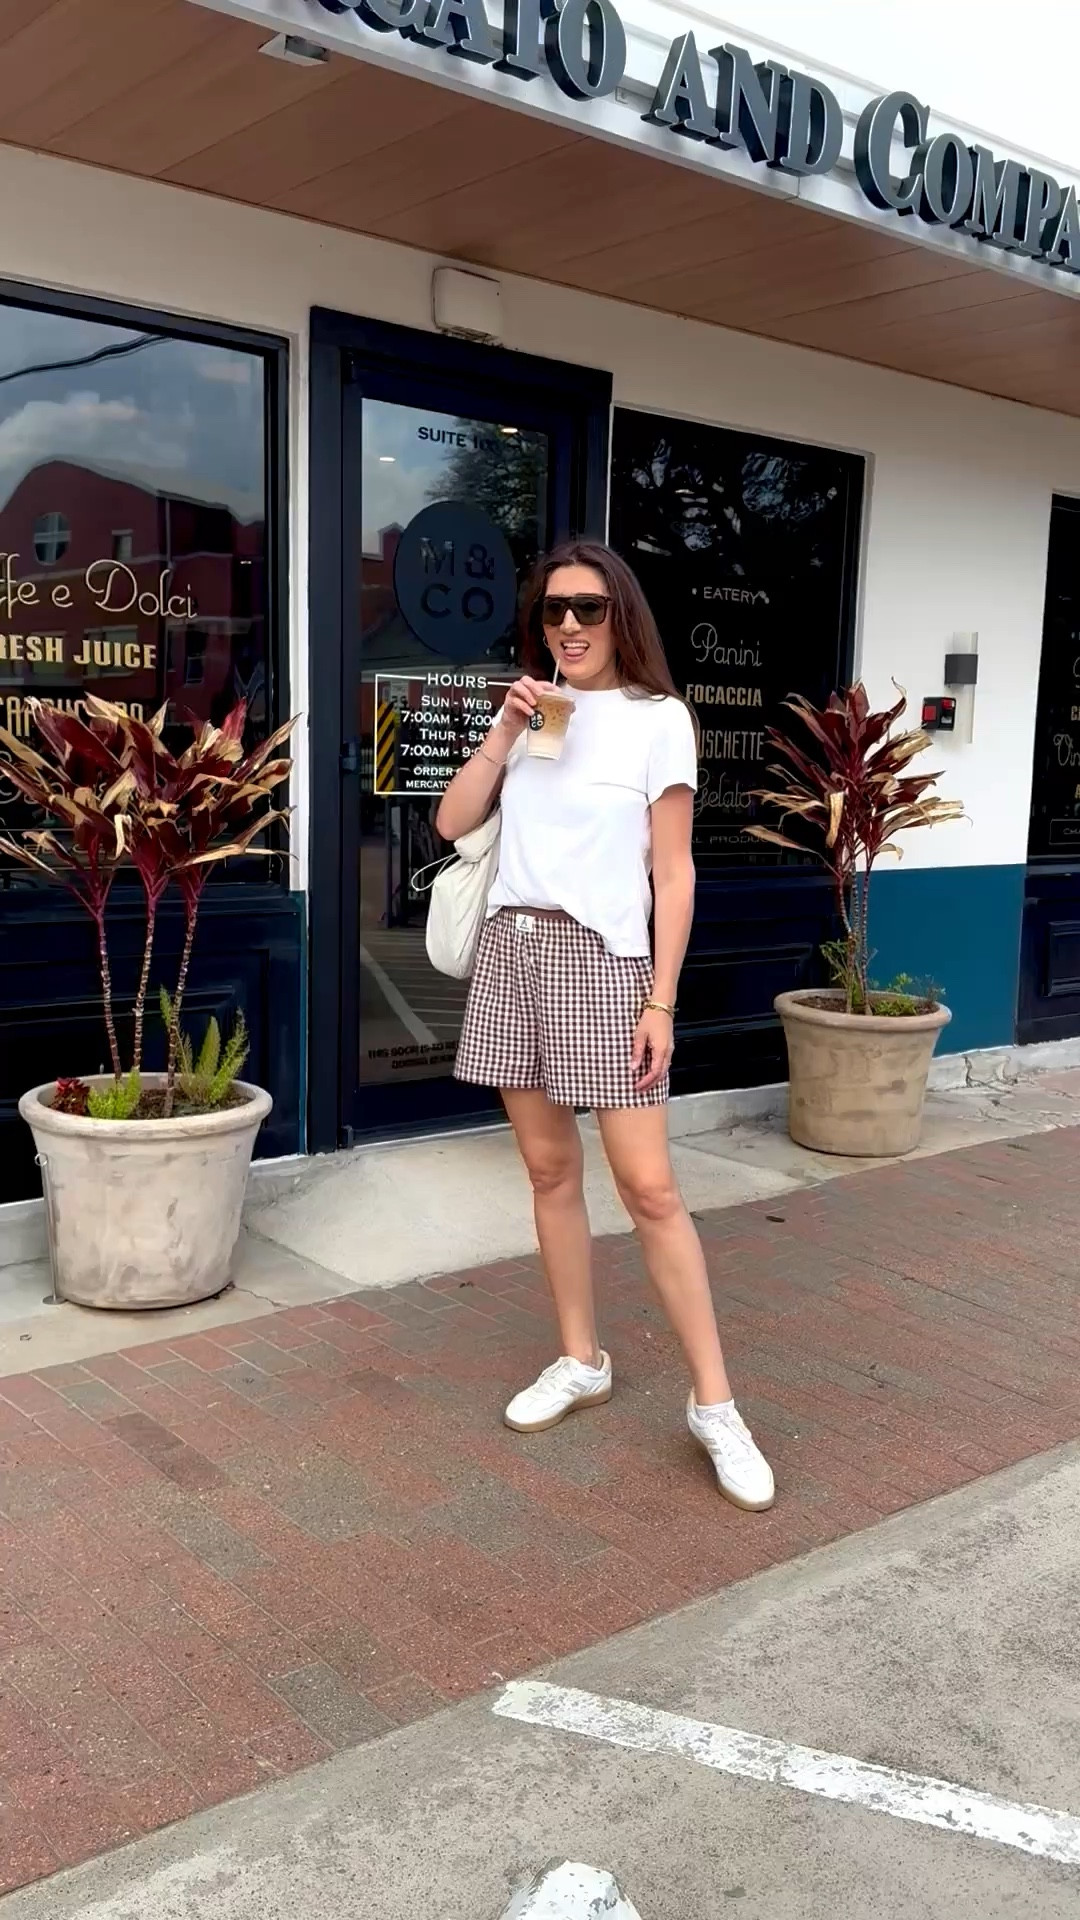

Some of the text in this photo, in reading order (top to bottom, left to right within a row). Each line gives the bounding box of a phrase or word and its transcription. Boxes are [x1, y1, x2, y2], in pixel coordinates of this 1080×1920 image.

[641, 30, 843, 176] AND
[418, 426, 466, 448] SUITE
[51, 584, 73, 608] e
[85, 558, 197, 619] Dolci
[703, 586, 761, 605] EATERY
[421, 583, 494, 622] CO
[73, 639, 157, 669] JUICE
[691, 622, 763, 667] Panini
[427, 672, 487, 688] HOURS
[421, 695, 450, 708] SUN
[462, 697, 492, 710] WED
[686, 683, 763, 707] FOCACCIA
[401, 710, 450, 724] 7:00AM
[420, 728, 456, 741] THUR
[400, 744, 449, 757] 7:00AM
[413, 767, 453, 776] ORDER
